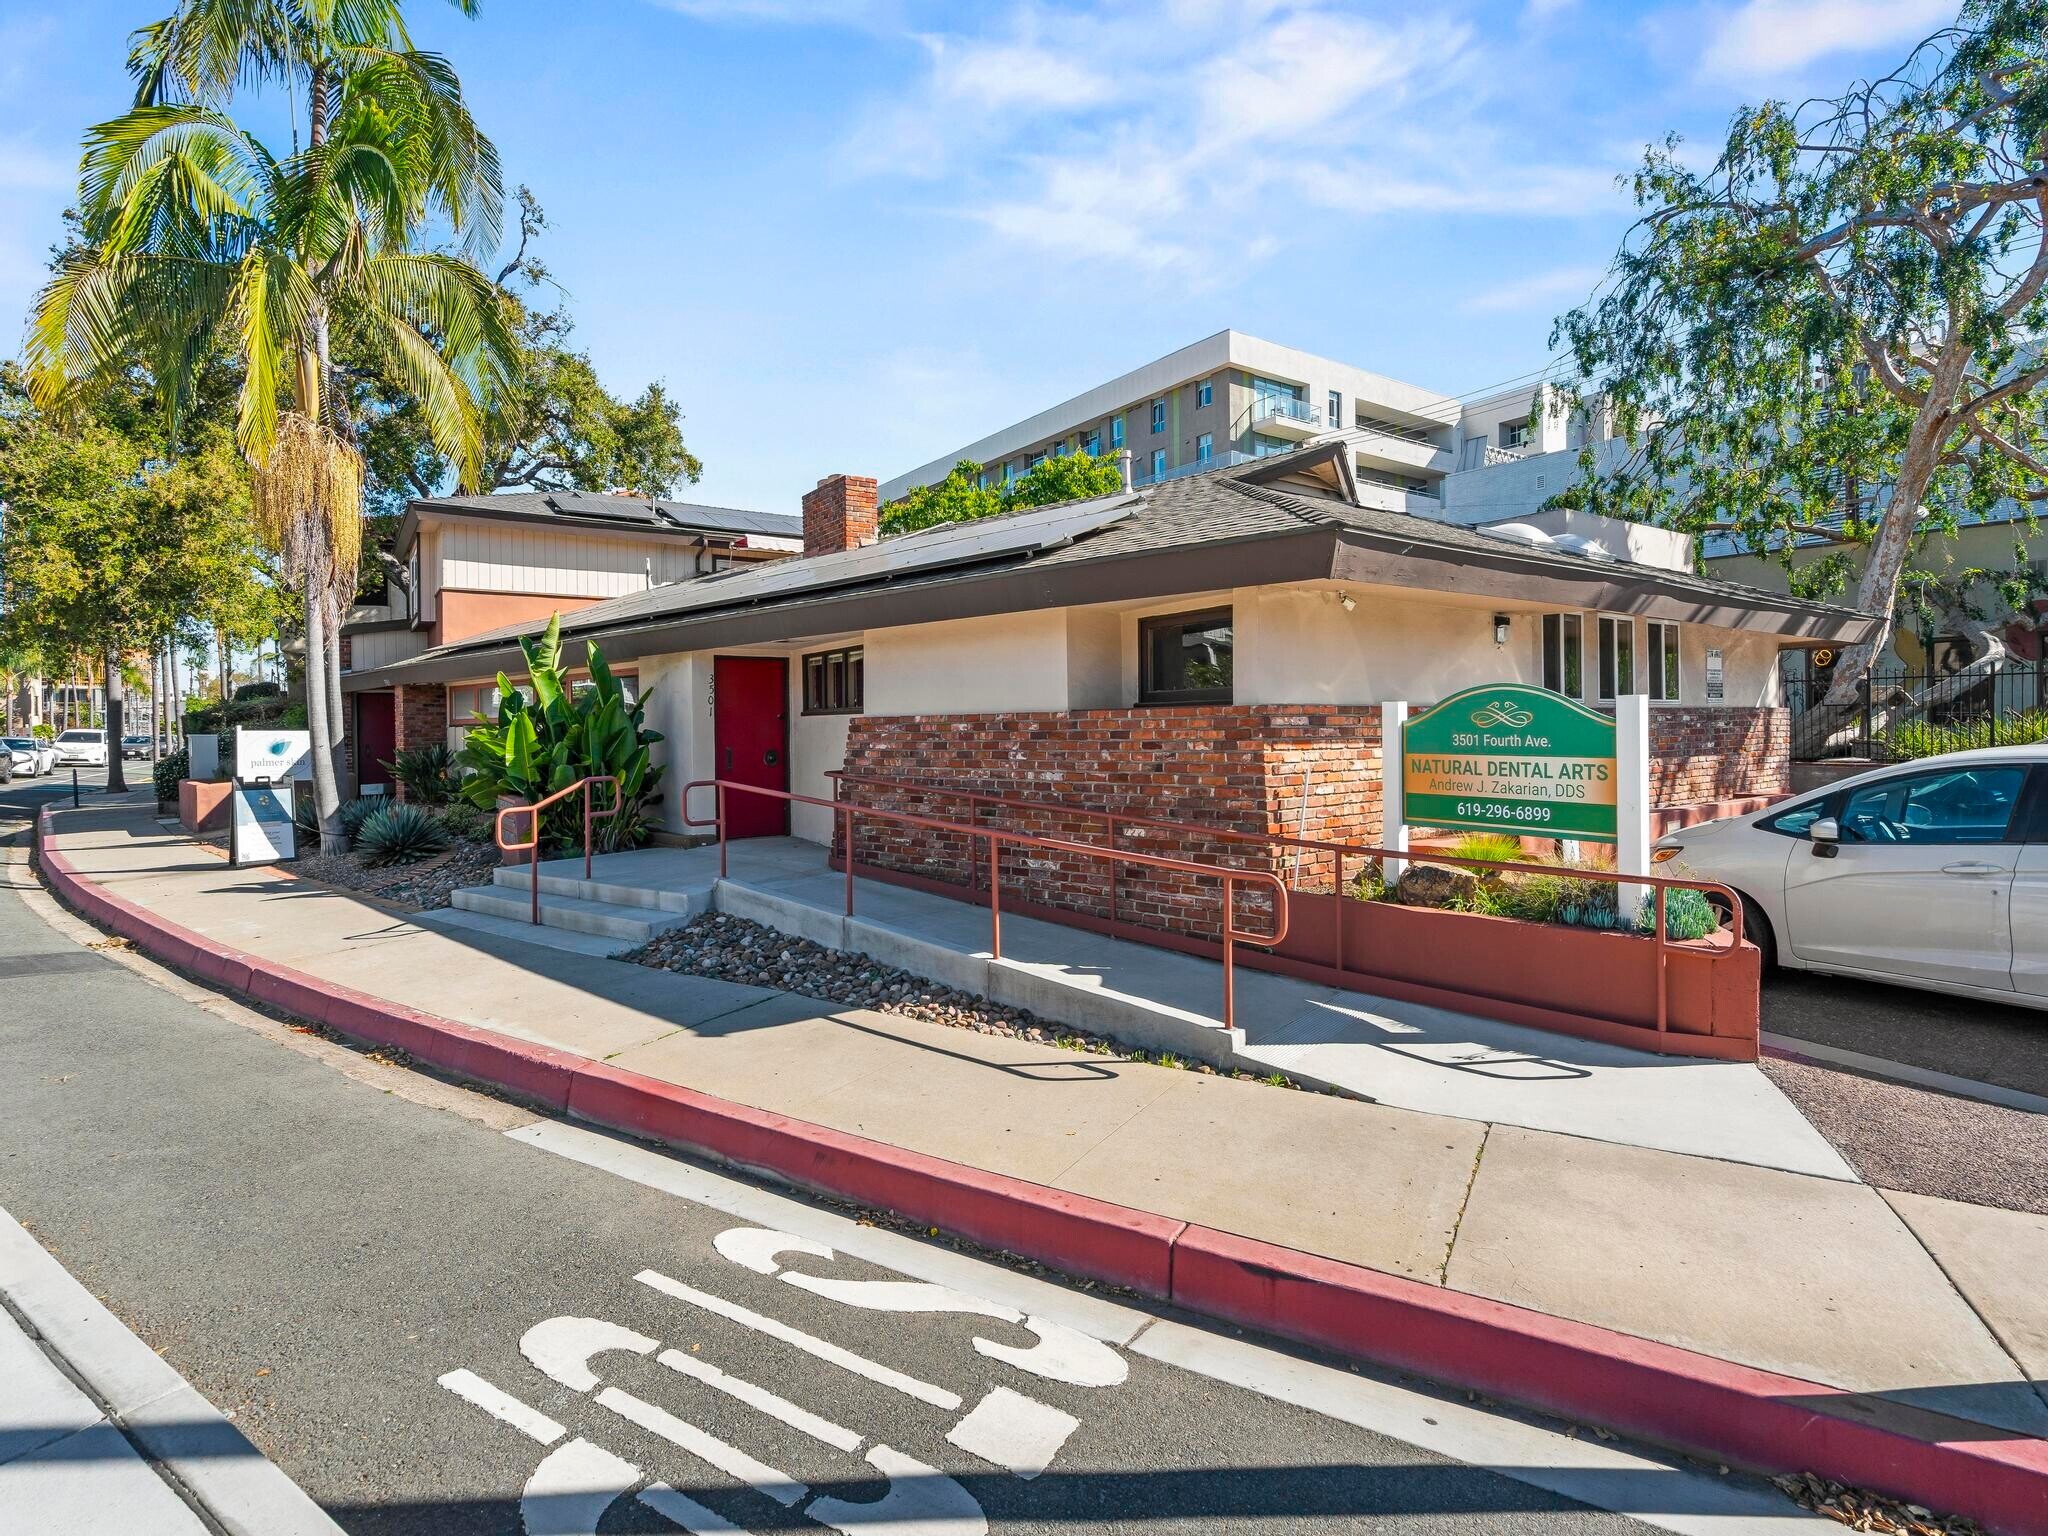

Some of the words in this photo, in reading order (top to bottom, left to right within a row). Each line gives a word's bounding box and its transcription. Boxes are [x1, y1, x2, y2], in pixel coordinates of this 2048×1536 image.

[1452, 734, 1479, 746] 3501
[1483, 734, 1521, 747] Fourth
[1524, 735, 1551, 748] Ave.
[251, 758, 284, 769] palmer
[286, 758, 305, 767] skin
[1411, 759, 1482, 776] NATURAL
[1487, 761, 1553, 779] DENTAL
[1558, 763, 1609, 781] ARTS
[1429, 778, 1473, 791] Andrew
[1476, 780, 1488, 793] J.
[1491, 781, 1551, 797] Zakarian,
[1555, 784, 1585, 798] DDS
[1457, 802, 1551, 821] 619-296-6899
